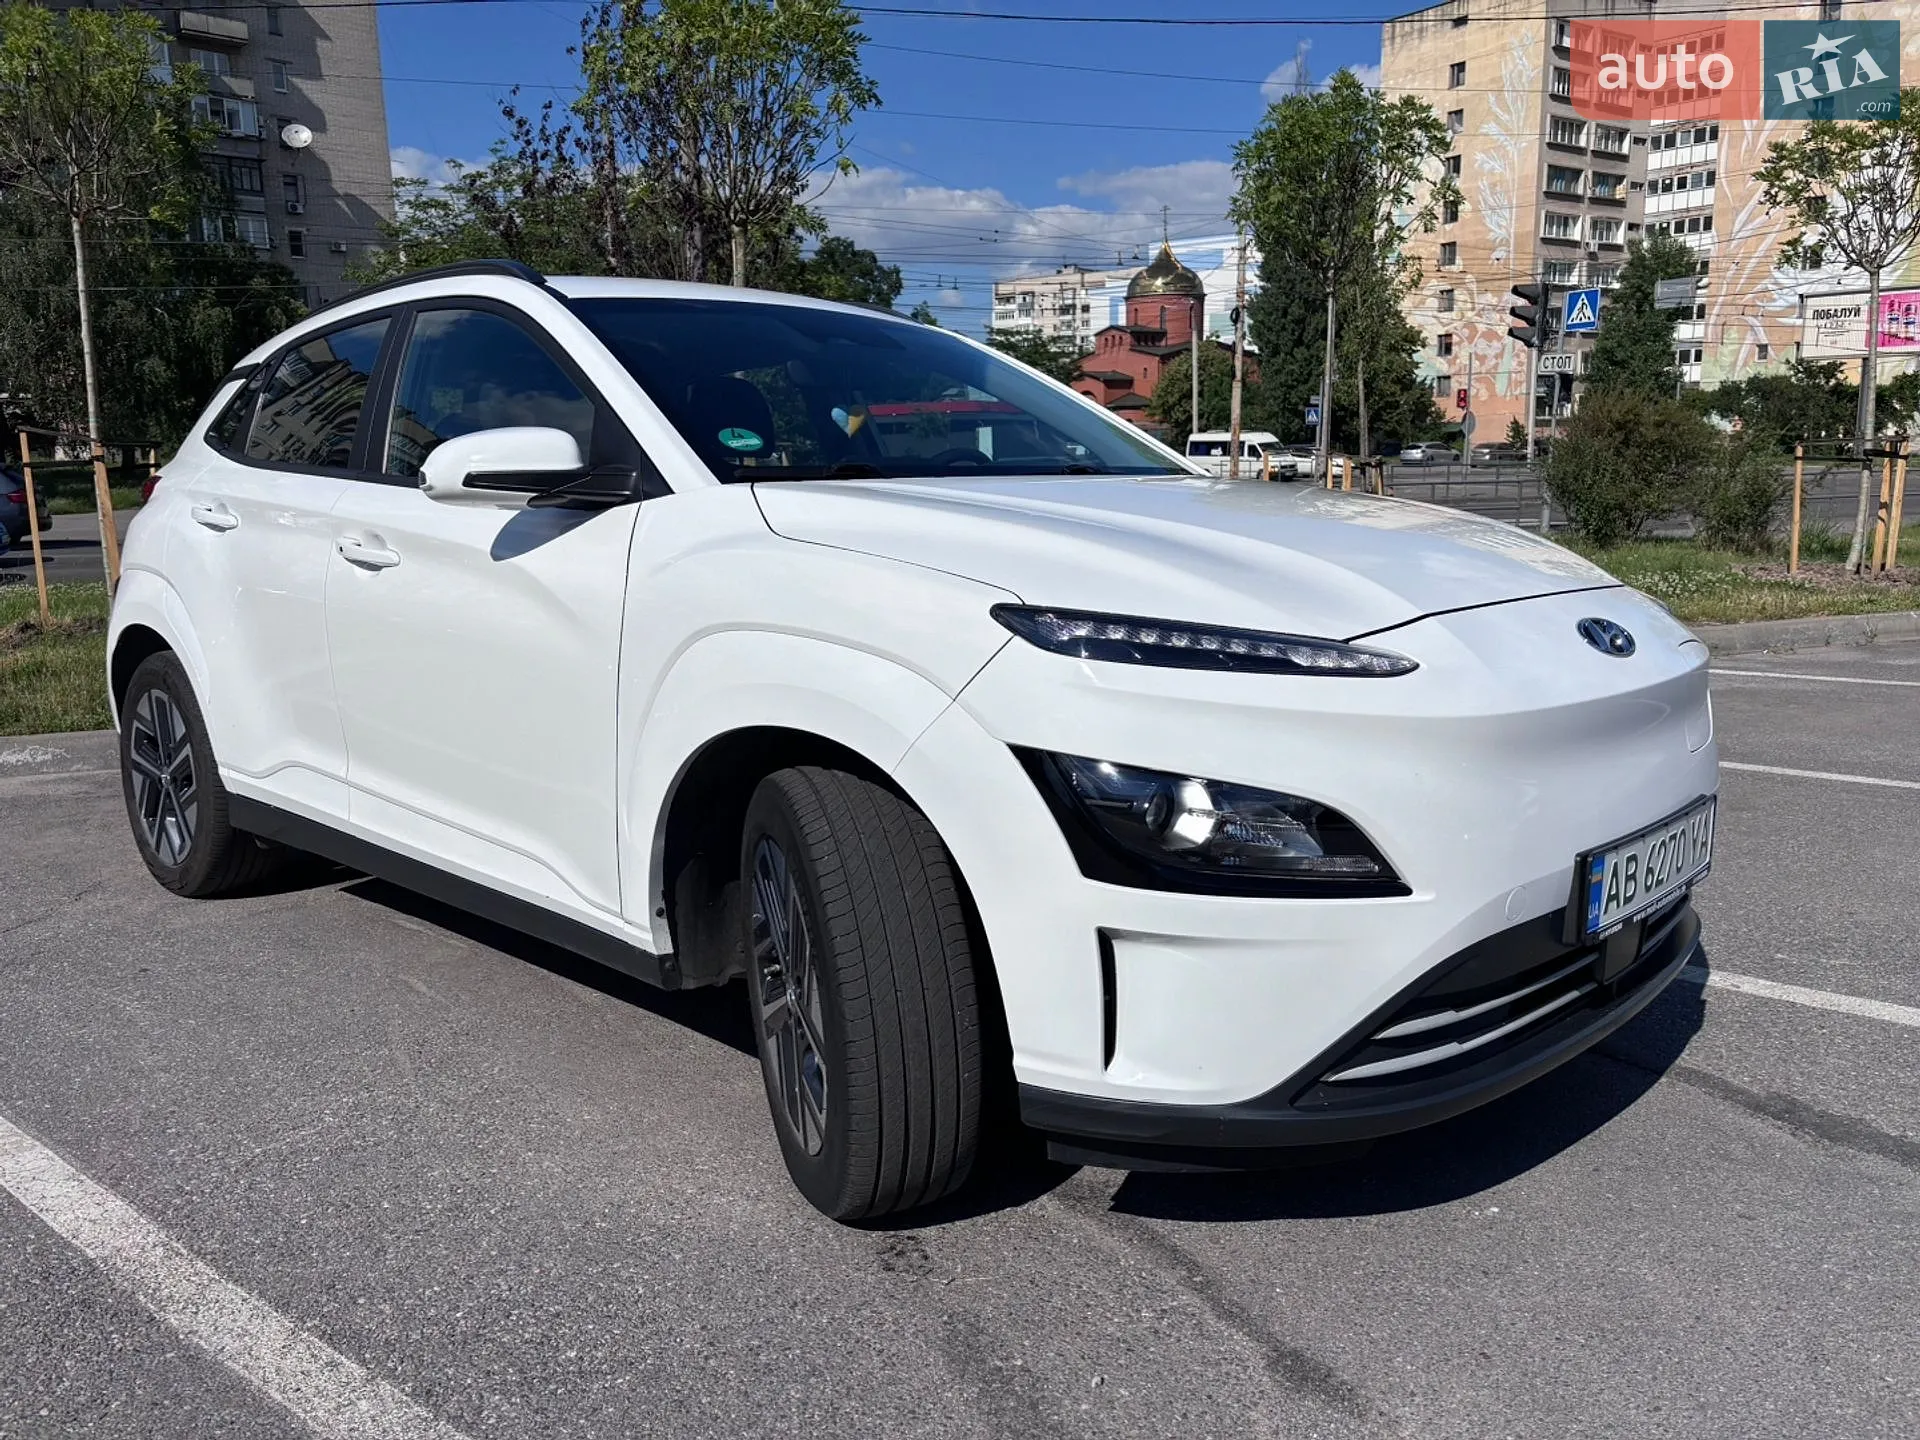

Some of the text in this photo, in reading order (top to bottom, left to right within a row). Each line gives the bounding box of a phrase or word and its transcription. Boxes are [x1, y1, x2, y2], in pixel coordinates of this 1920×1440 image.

[1812, 304, 1861, 320] ПОБАЛУЙ
[1543, 356, 1571, 369] СТОП
[1603, 852, 1638, 915] AB
[1643, 827, 1686, 893] 6270
[1690, 811, 1708, 865] YA
[1588, 901, 1599, 918] UA
